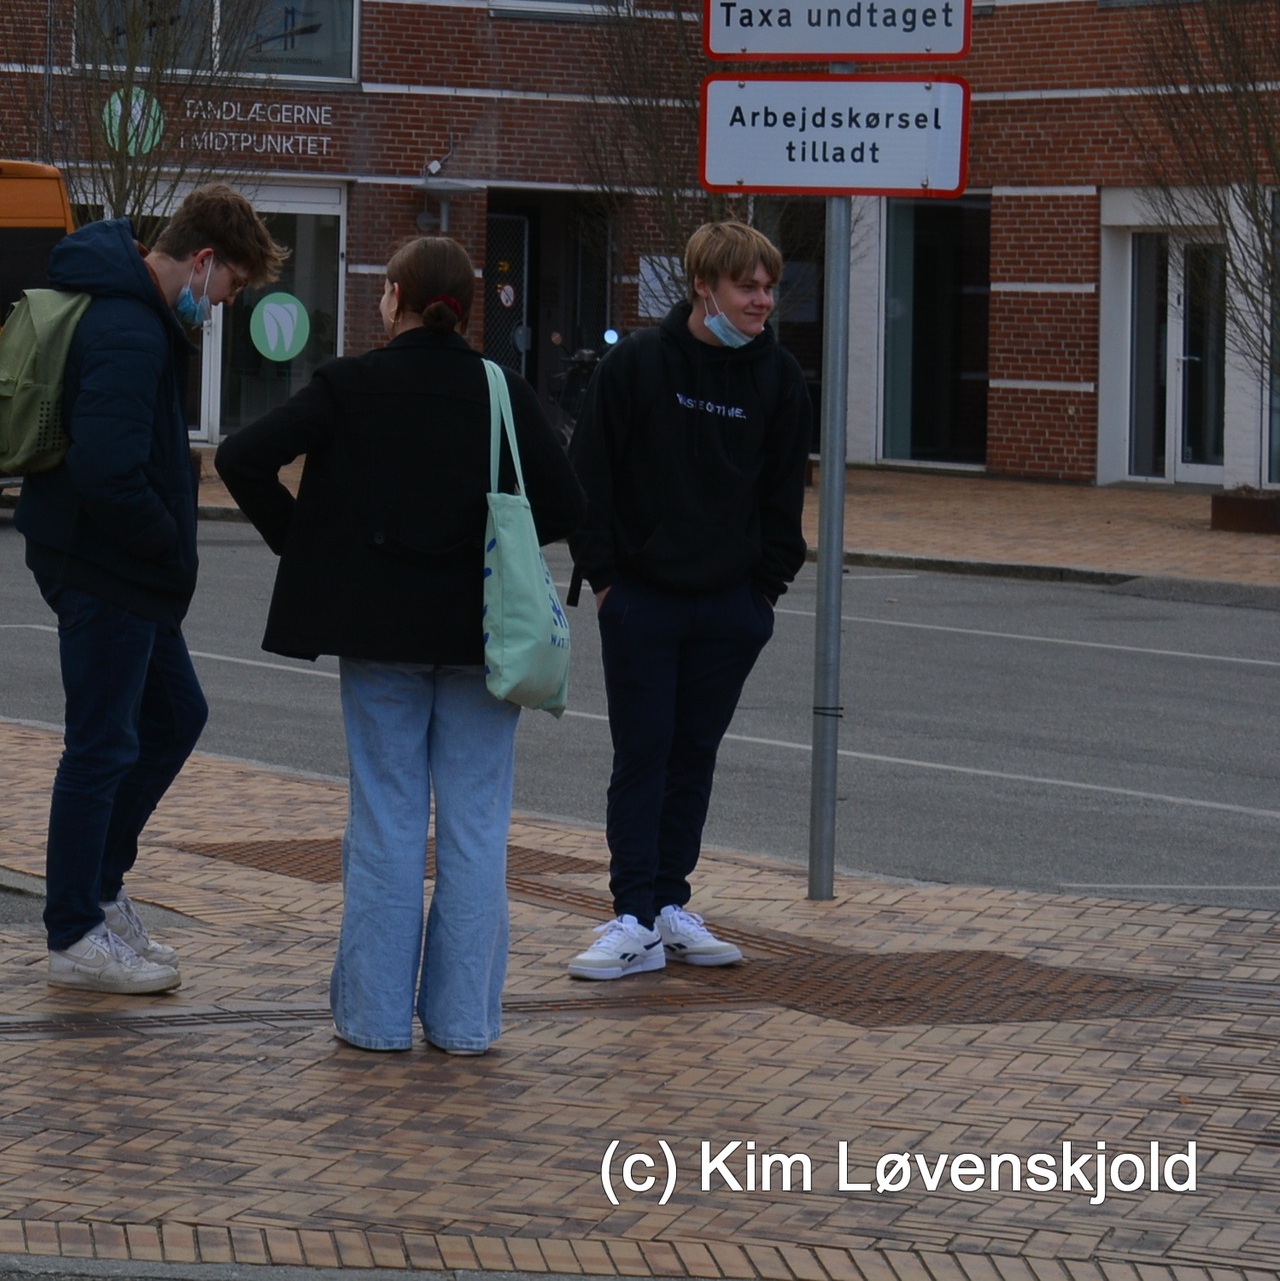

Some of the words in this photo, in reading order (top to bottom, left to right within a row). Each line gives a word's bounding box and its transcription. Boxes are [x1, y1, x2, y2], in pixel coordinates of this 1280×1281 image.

[720, 1, 792, 28] Taxa
[807, 1, 954, 33] undtaget
[184, 99, 333, 126] TANDLÆGERNE
[729, 105, 942, 132] Arbejdskørsel
[191, 131, 332, 156] MIDTPUNKTET
[785, 140, 880, 163] tilladt
